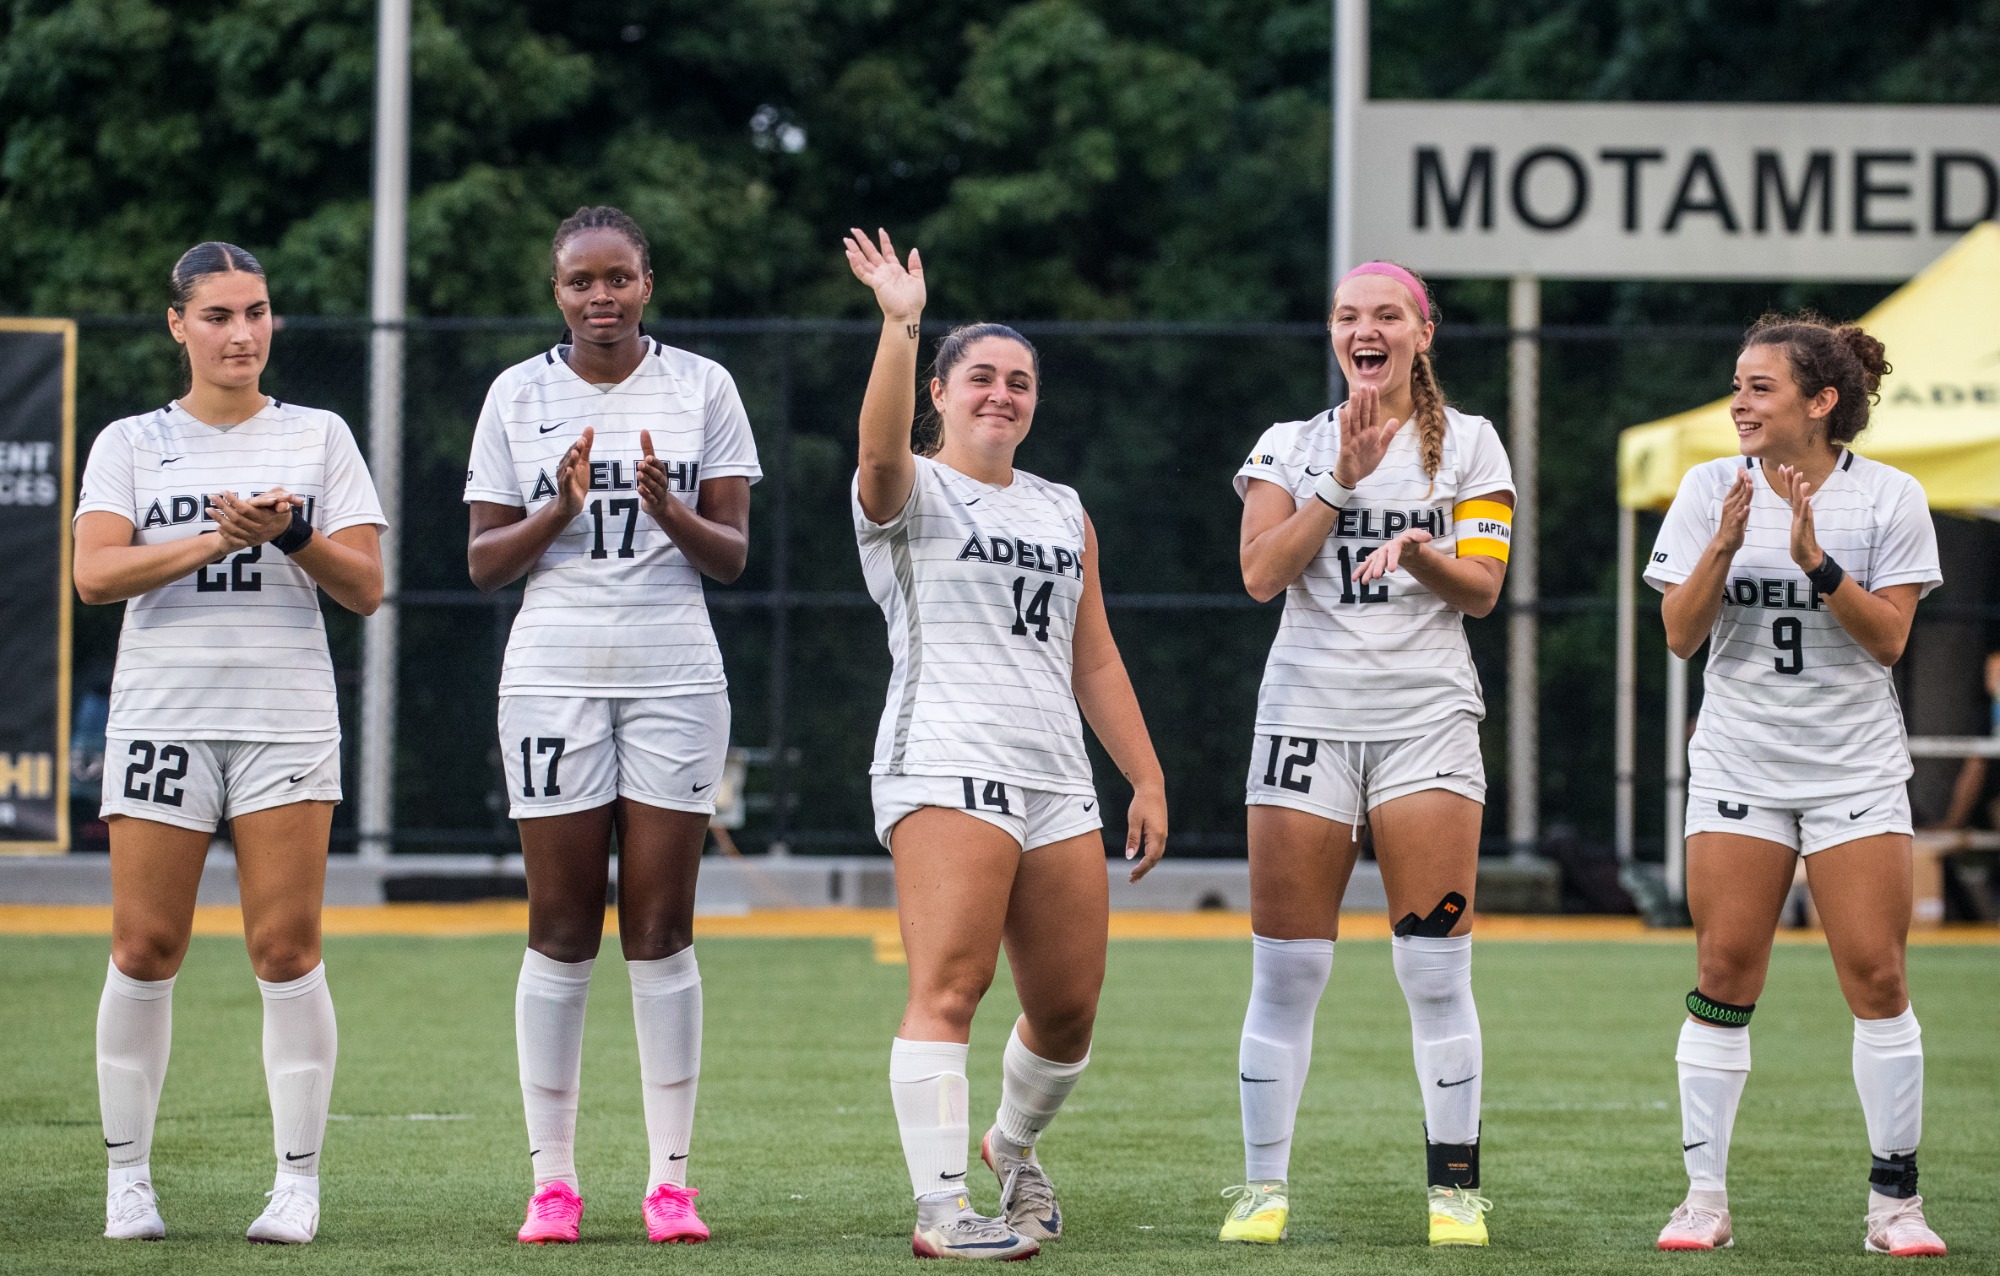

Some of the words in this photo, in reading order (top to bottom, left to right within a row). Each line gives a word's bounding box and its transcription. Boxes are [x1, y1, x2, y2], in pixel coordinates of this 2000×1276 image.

[1411, 143, 2000, 236] MOTAMED
[589, 498, 639, 559] 17
[1011, 575, 1054, 642] 14
[1772, 616, 1804, 675] 9
[123, 739, 190, 808] 22
[520, 736, 566, 798] 17
[1263, 734, 1318, 795] 12
